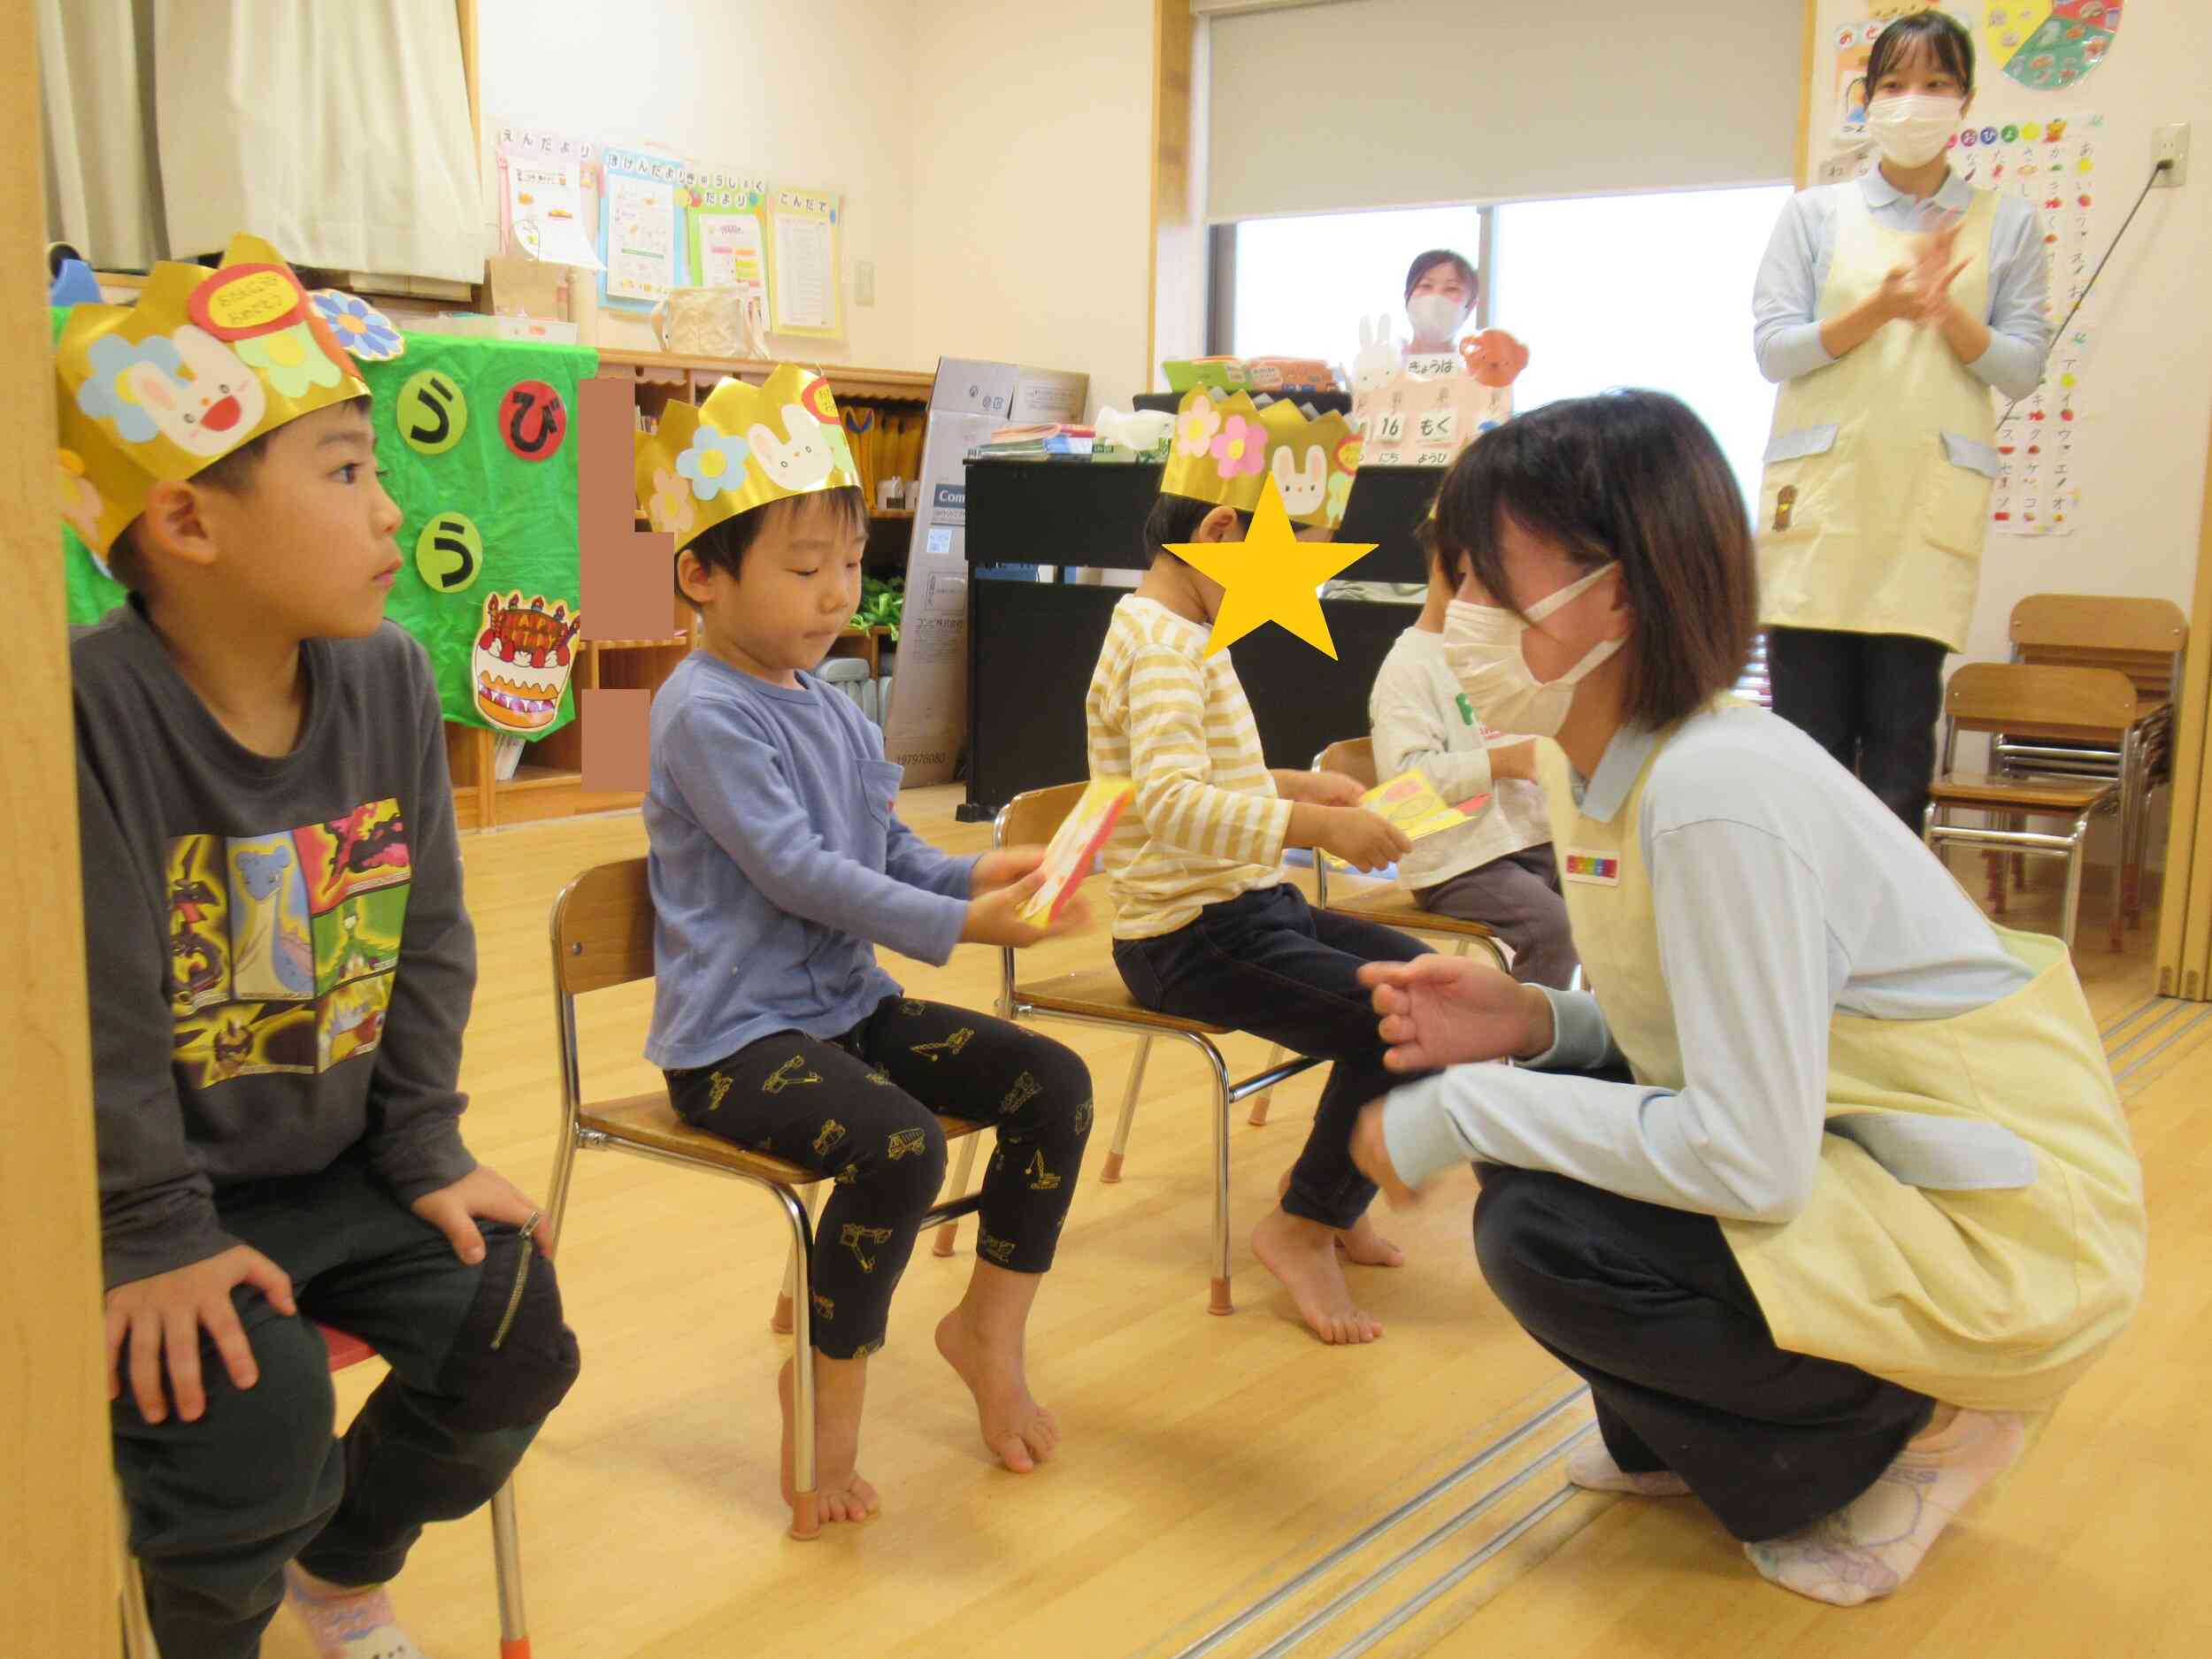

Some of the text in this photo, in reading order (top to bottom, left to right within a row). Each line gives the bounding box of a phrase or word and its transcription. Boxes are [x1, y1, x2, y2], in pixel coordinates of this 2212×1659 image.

[503, 128, 589, 157] えんだより
[706, 192, 746, 206] だより
[780, 191, 828, 213] こんだて
[1409, 360, 1454, 374] きょうは
[1382, 418, 1399, 435] 16
[1421, 416, 1451, 435] もく
